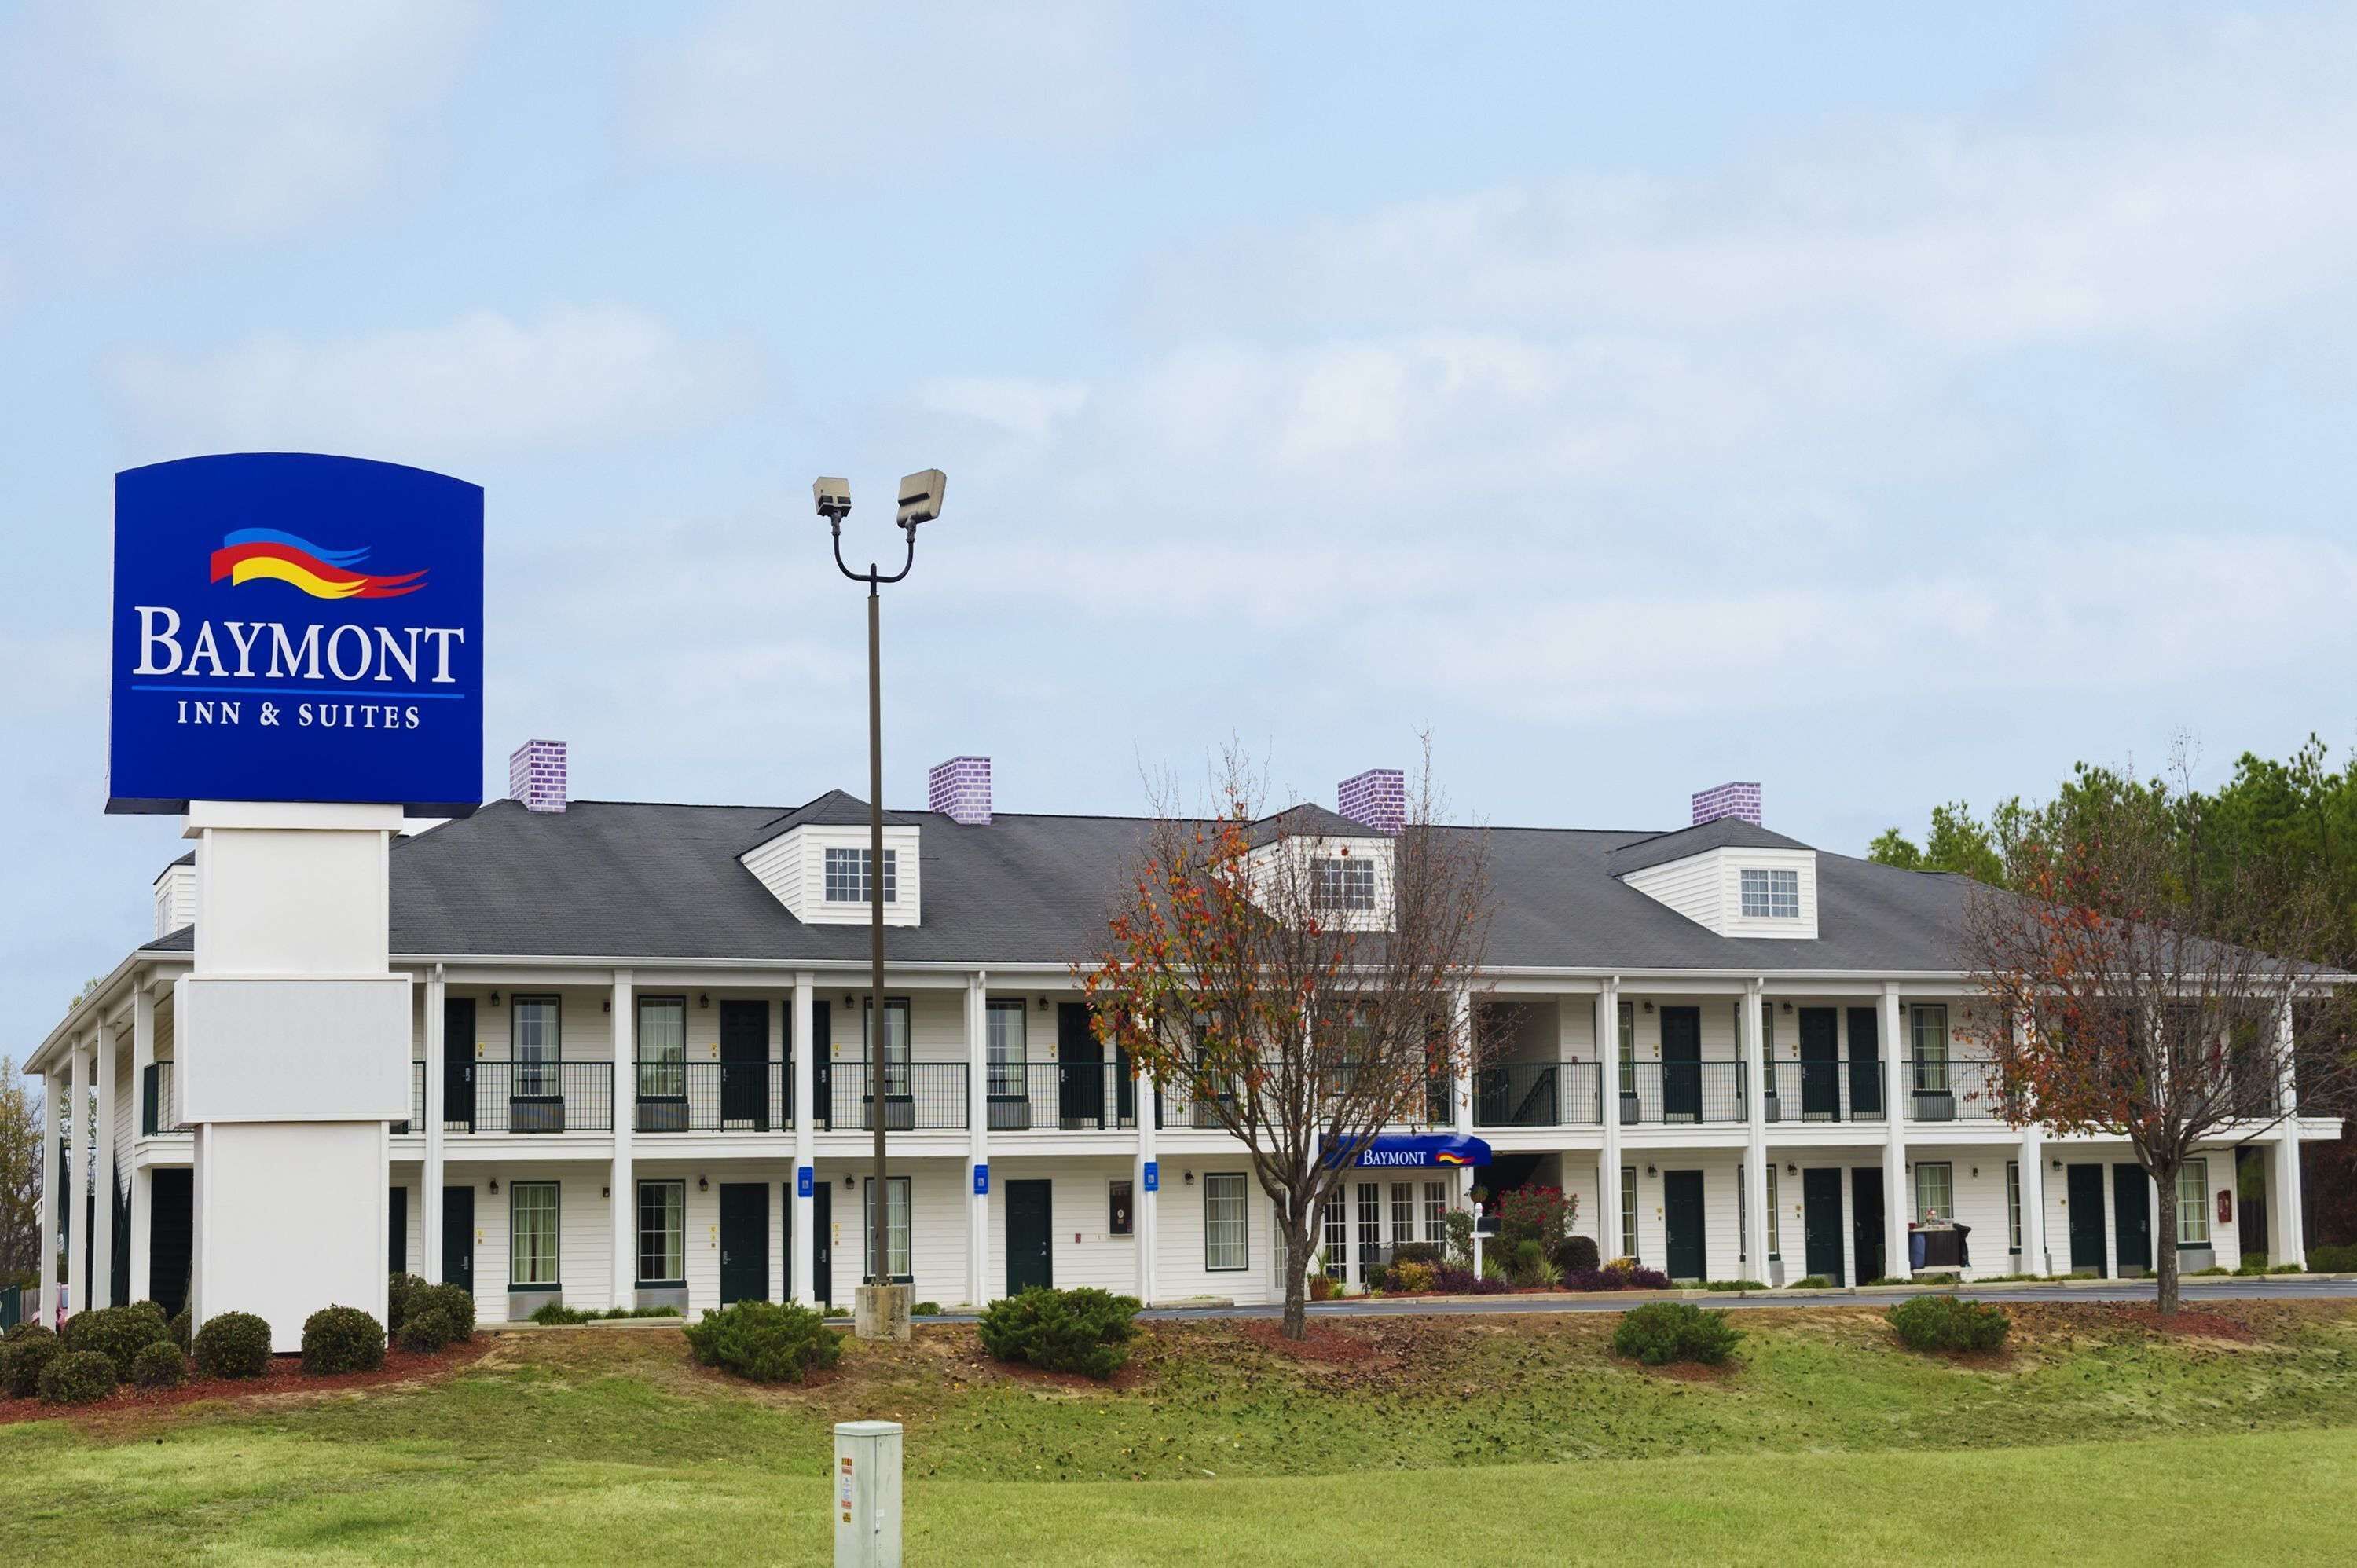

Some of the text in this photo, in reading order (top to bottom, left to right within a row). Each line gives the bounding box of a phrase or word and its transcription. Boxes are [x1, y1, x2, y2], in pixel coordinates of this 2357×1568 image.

[134, 606, 464, 682] BAYMONT
[178, 701, 419, 729] INN & SUITES
[1363, 1149, 1426, 1164] BAYMONT
